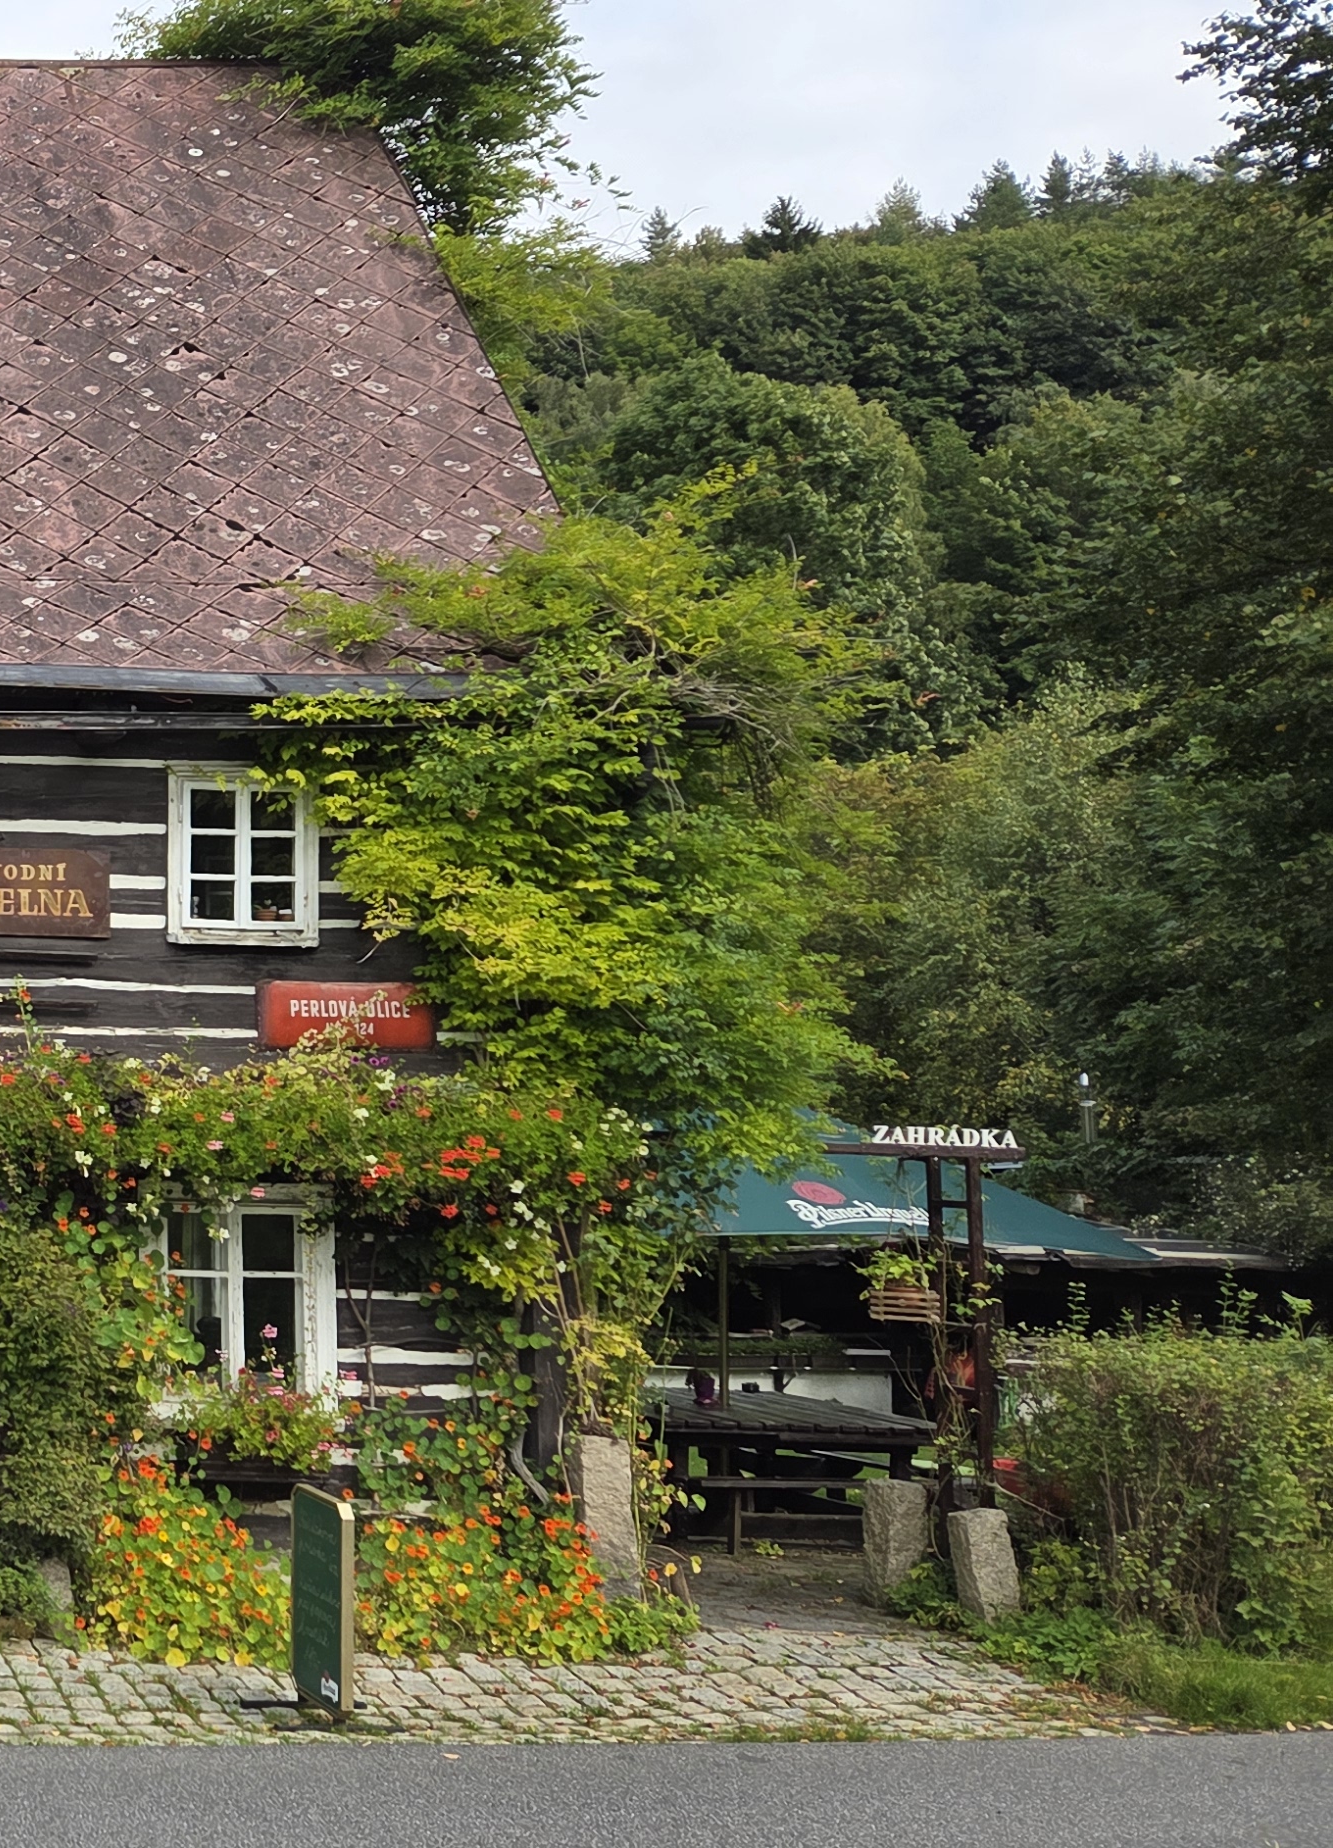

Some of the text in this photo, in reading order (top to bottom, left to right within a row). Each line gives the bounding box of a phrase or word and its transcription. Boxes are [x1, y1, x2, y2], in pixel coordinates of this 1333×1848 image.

[289, 996, 412, 1019] PERLOVÁ ULICE
[871, 1124, 1019, 1149] ZAHRÁDKA
